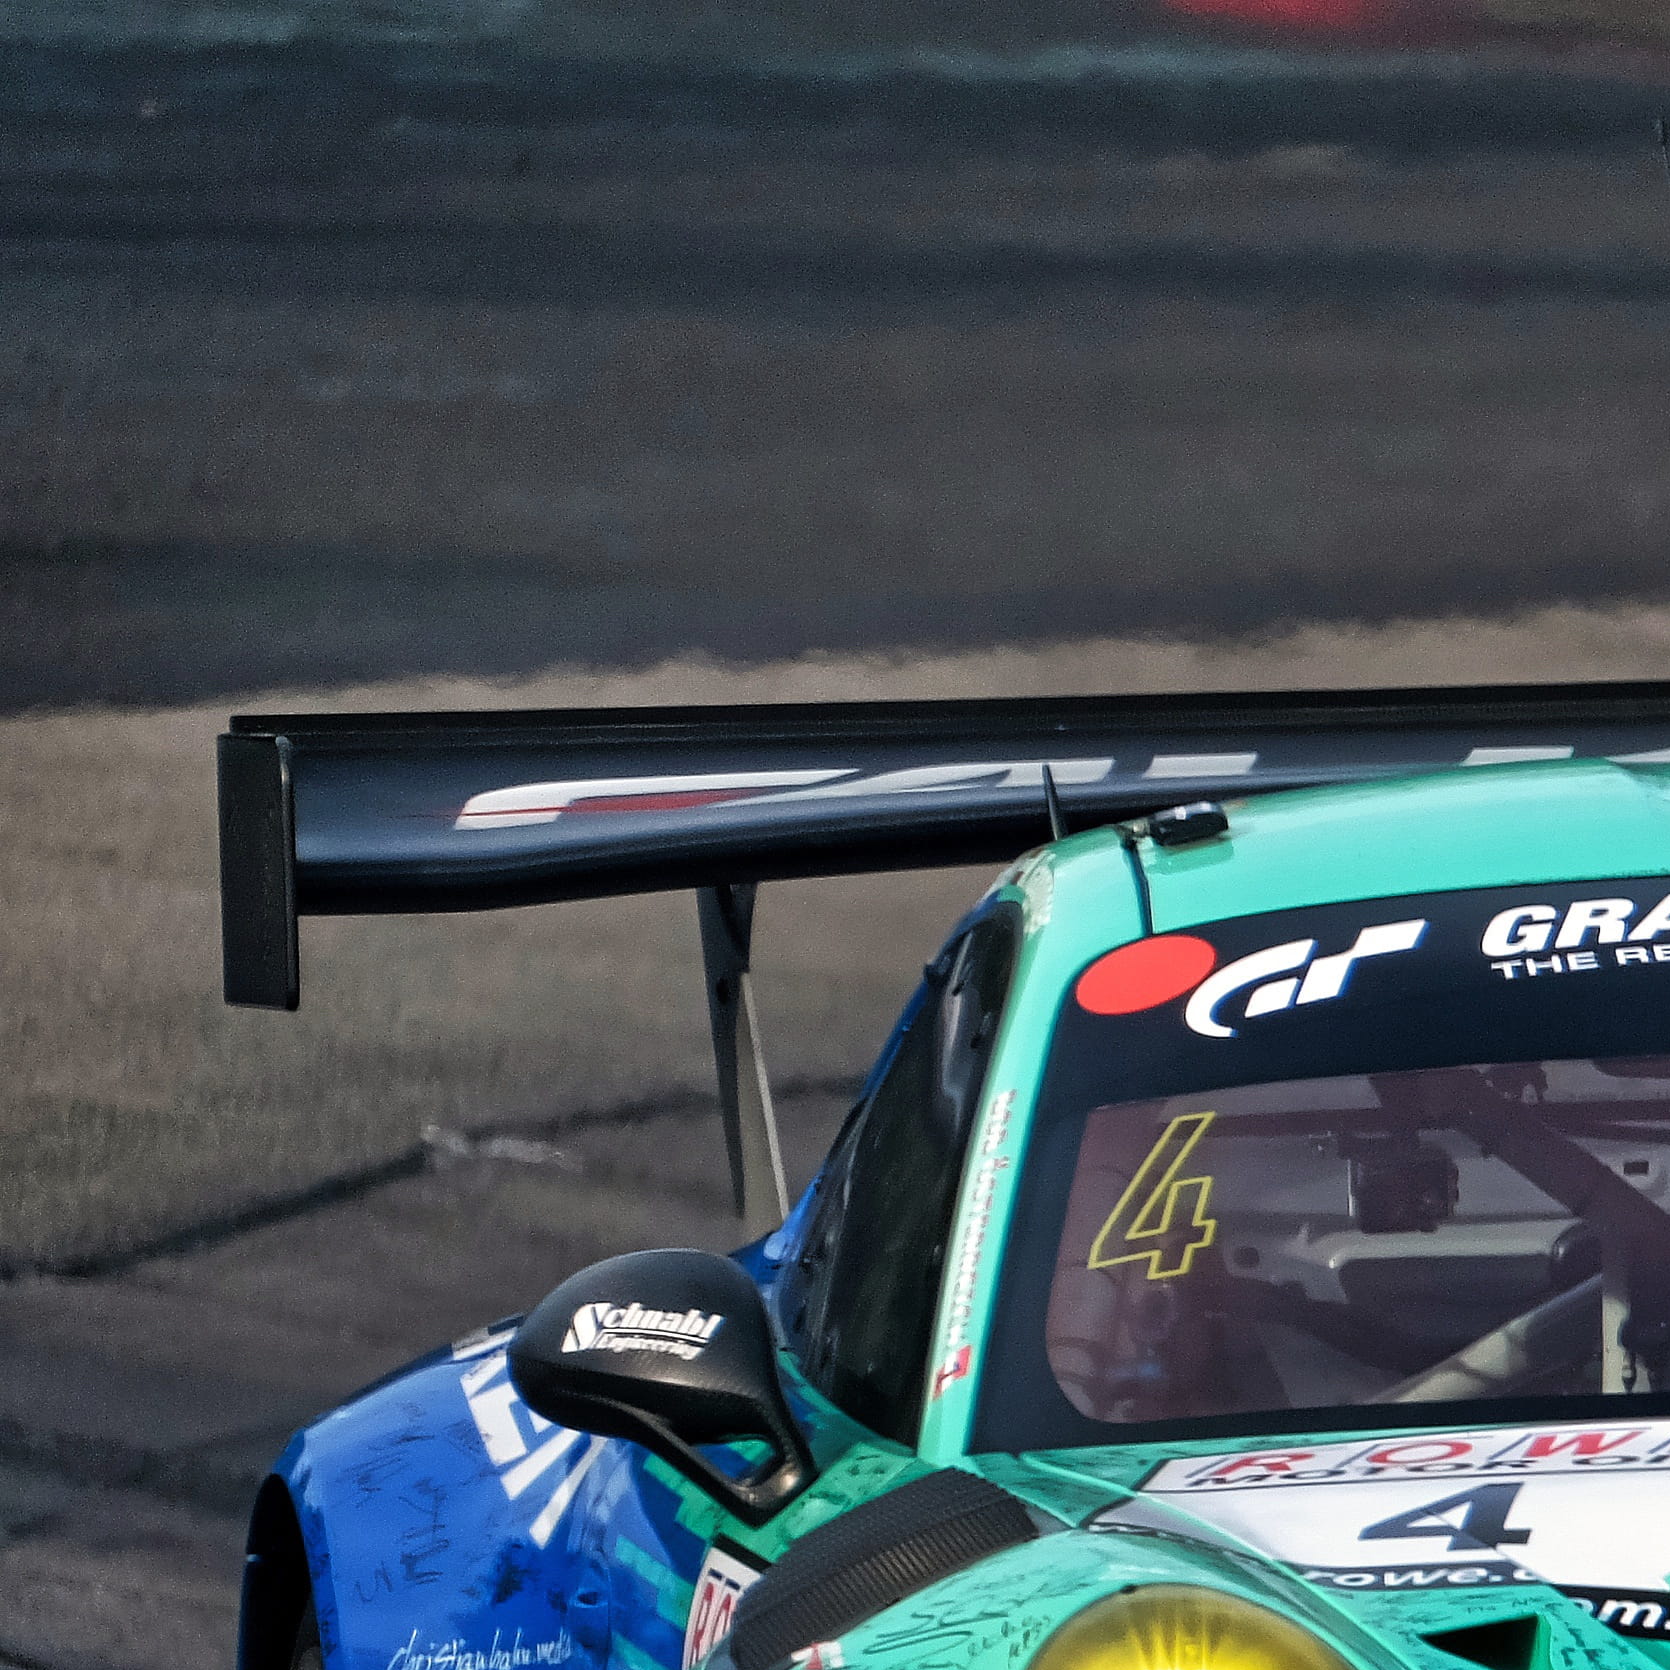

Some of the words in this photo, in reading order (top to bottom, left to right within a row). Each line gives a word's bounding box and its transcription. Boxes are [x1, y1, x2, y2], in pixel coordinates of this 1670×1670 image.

[1491, 957, 1599, 981] THE
[1087, 1111, 1216, 1281] 4
[1200, 1458, 1526, 1496] MOTOR
[1356, 1481, 1533, 1552] 4
